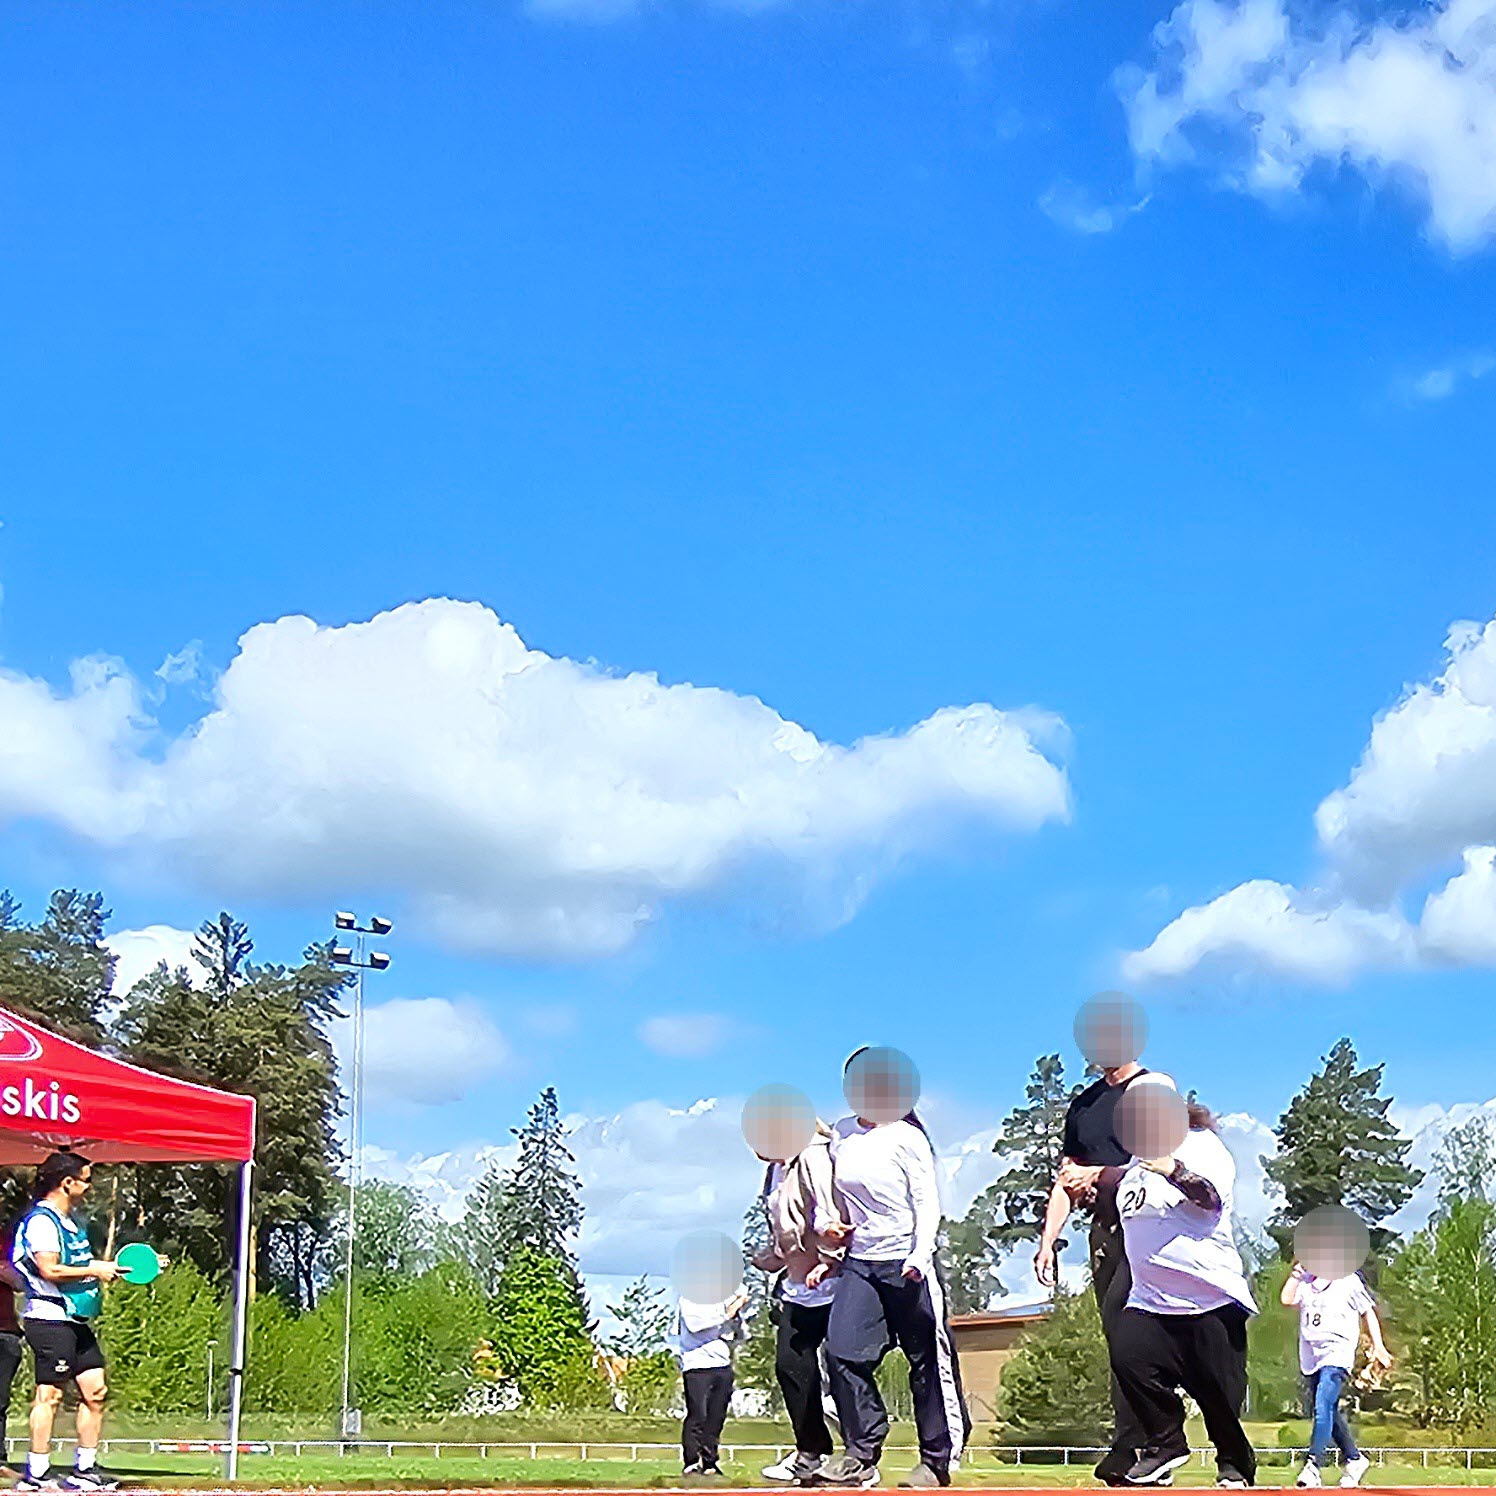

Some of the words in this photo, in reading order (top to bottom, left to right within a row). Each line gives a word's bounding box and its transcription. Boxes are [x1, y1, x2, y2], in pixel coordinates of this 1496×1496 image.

[1, 1077, 81, 1123] skis
[1122, 1187, 1146, 1213] 20
[1305, 1312, 1322, 1327] 18
